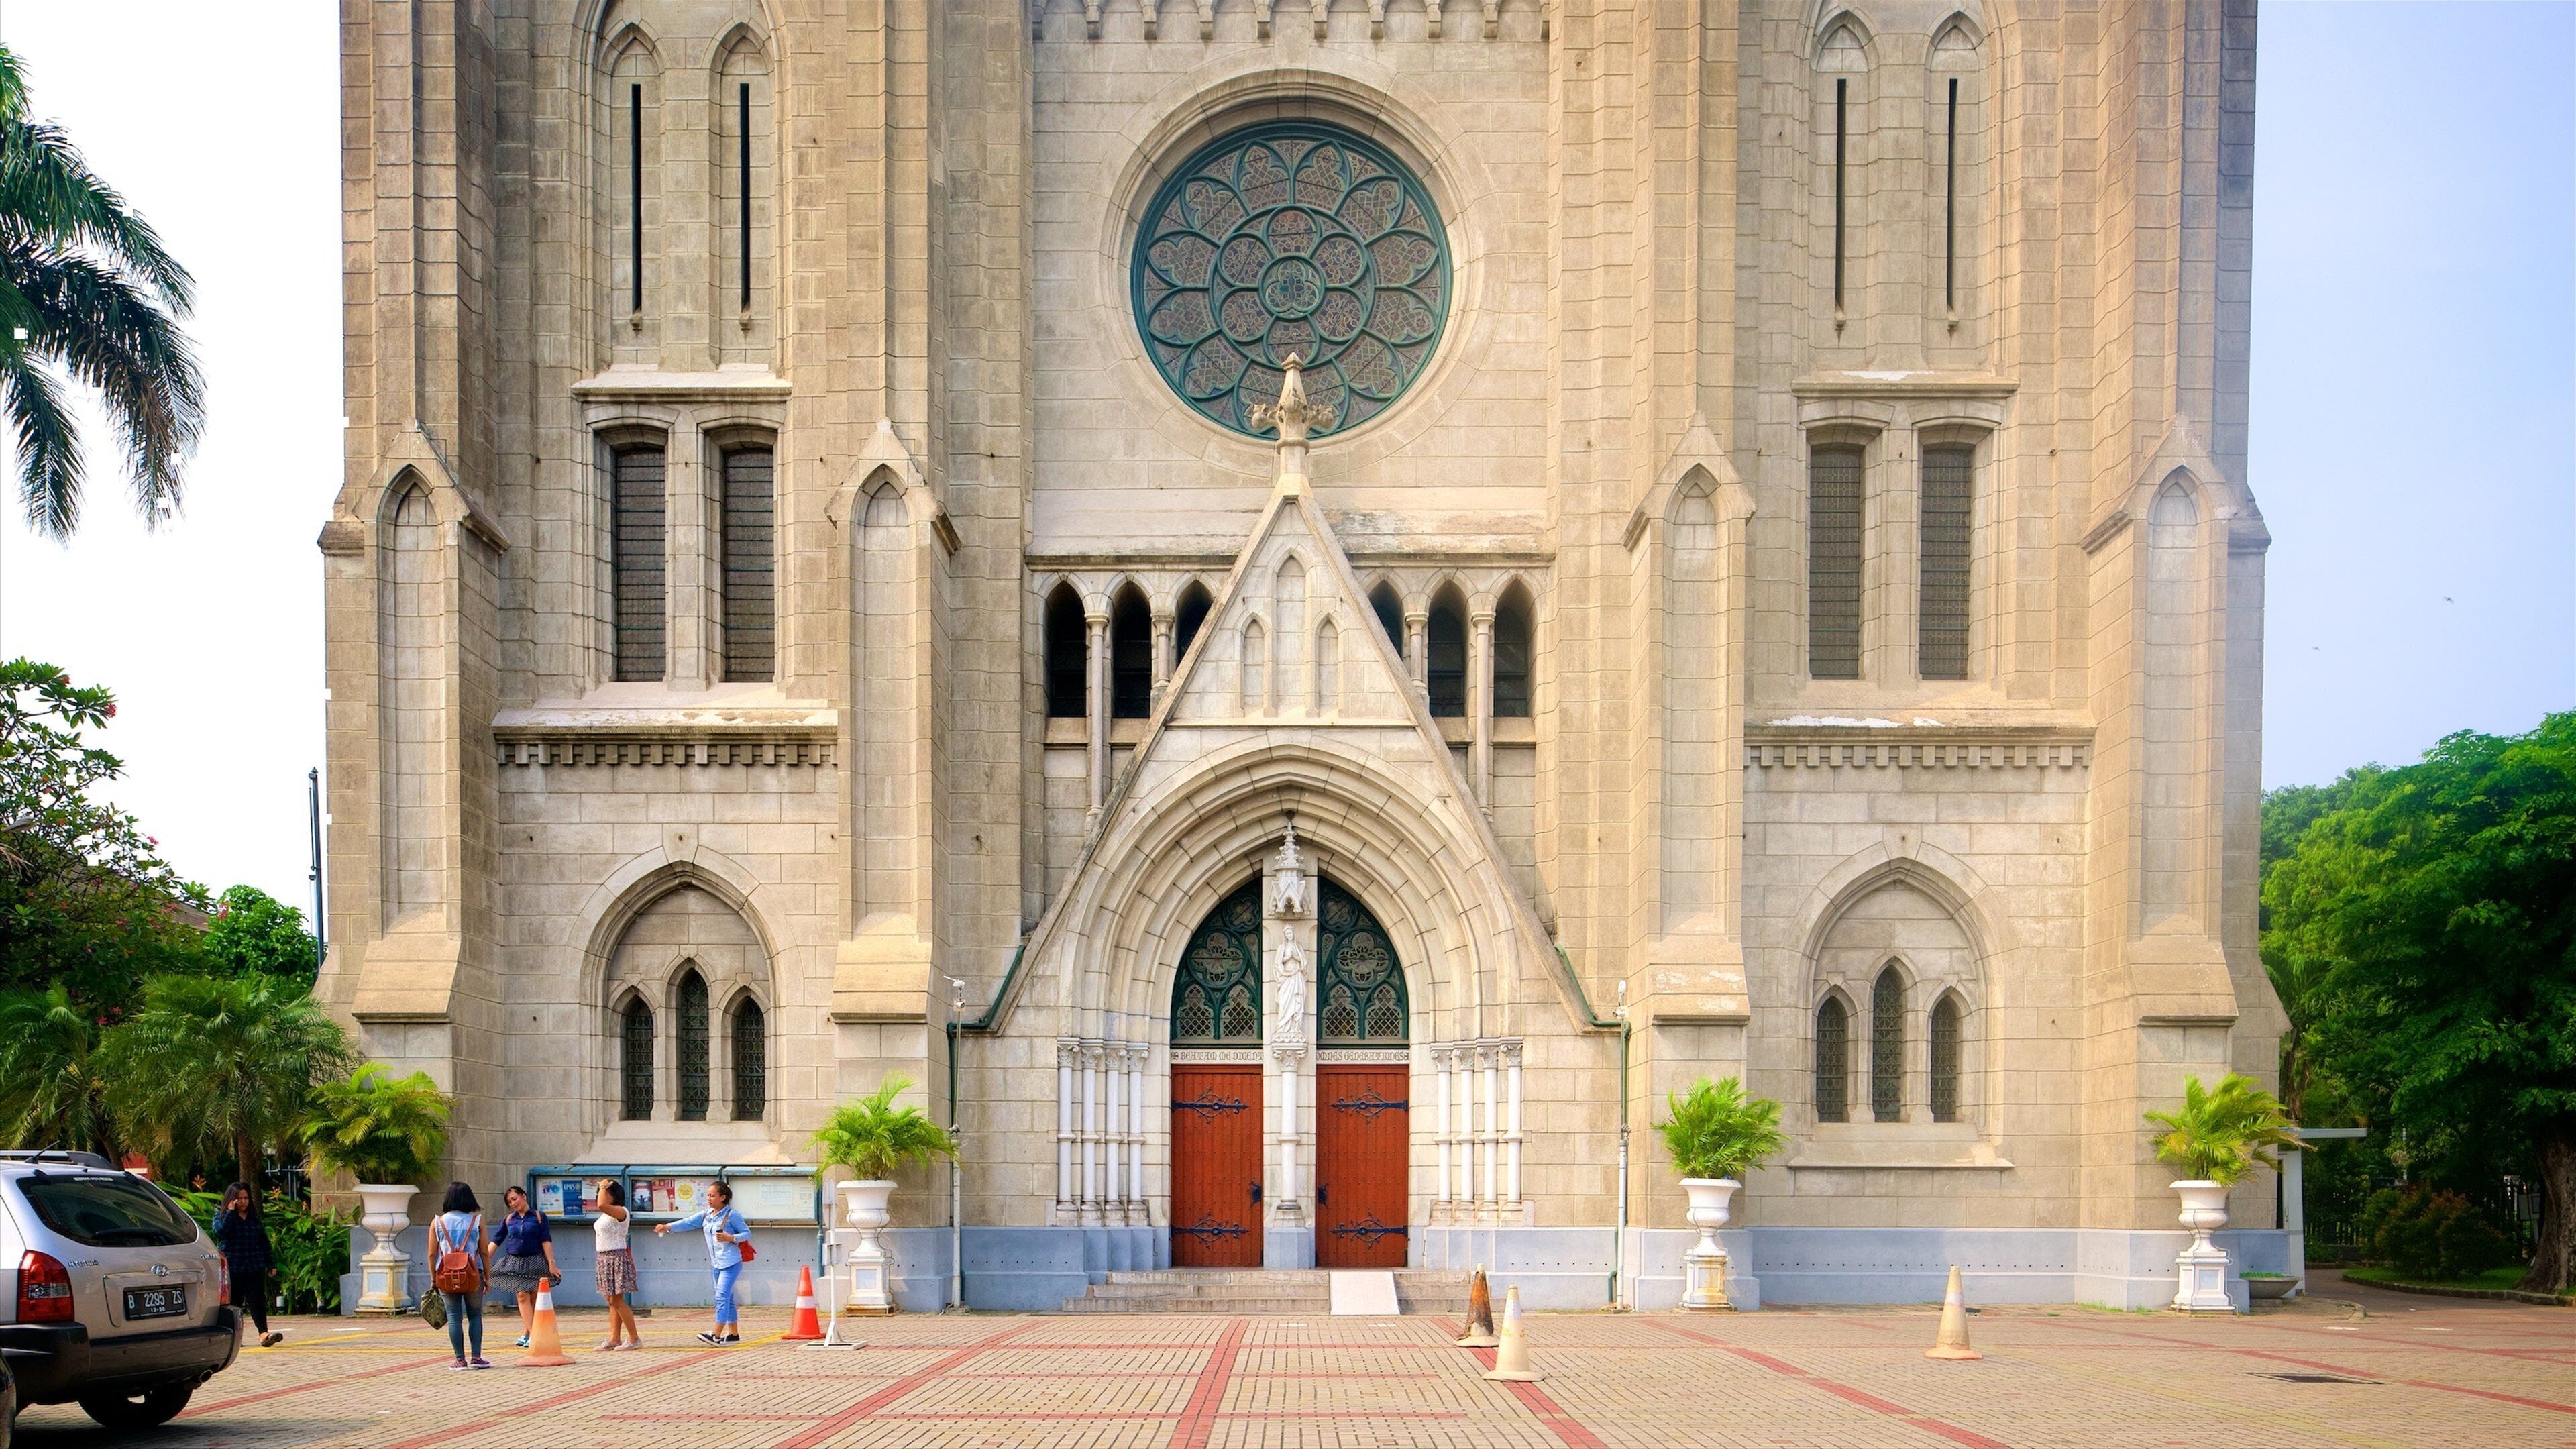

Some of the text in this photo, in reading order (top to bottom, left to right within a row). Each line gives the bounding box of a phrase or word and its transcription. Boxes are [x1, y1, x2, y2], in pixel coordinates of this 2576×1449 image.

[1181, 1051, 1264, 1061] BEATAM ME DICENT
[1316, 1051, 1342, 1061] OMNES
[128, 1290, 182, 1309] B 2295 ZS
